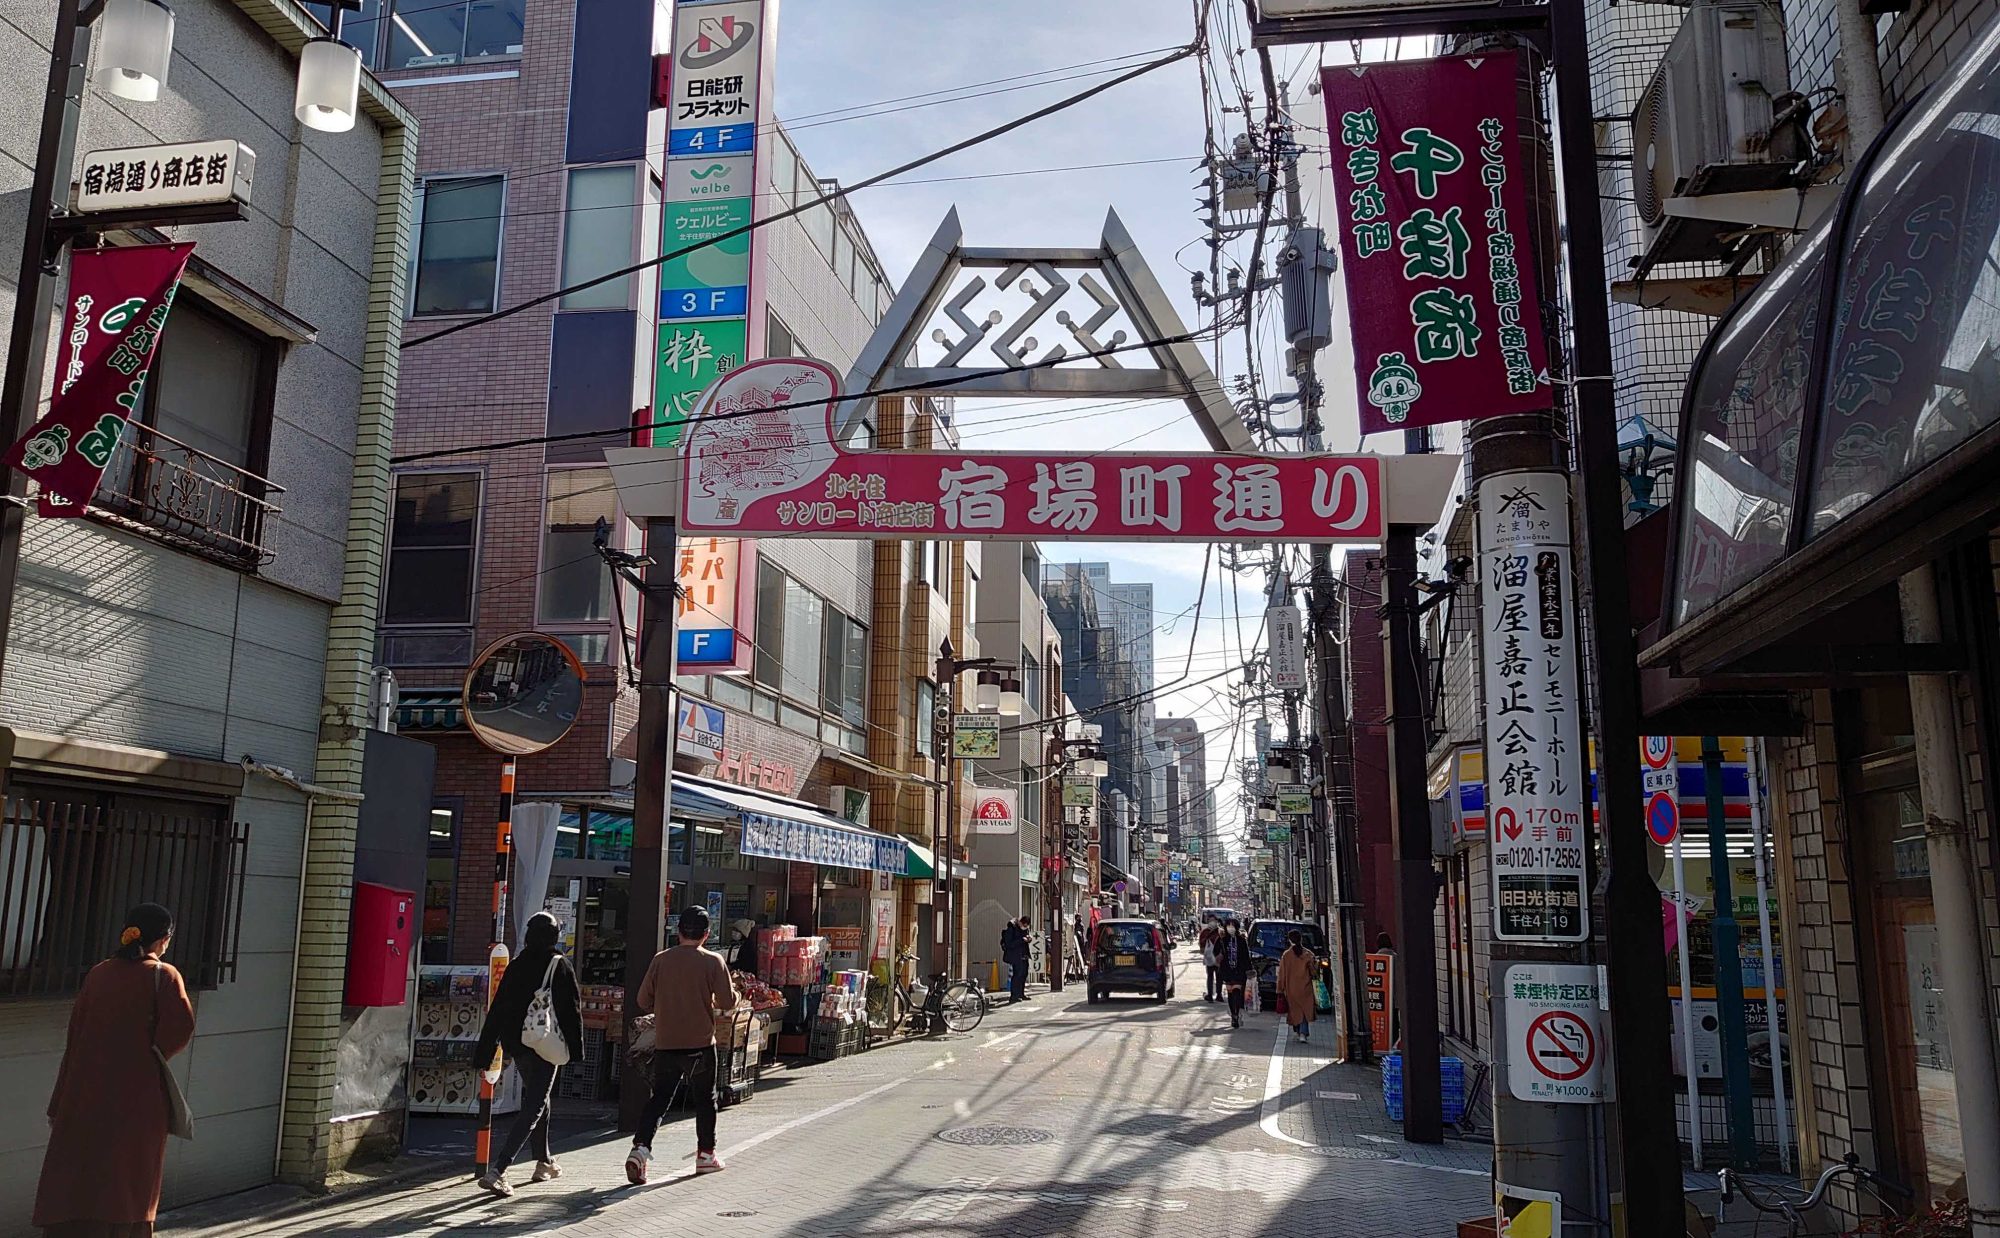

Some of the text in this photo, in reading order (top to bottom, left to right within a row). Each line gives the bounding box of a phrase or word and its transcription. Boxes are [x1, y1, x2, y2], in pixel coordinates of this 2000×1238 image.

[687, 75, 743, 98] 日能研
[678, 97, 750, 121] プラネット
[84, 152, 229, 197] 宿場通り商店街
[690, 183, 731, 195] welbe
[675, 212, 742, 230] ウェルビー
[825, 474, 886, 500] 北千住
[939, 459, 1371, 533] 宿場町通り
[777, 500, 936, 528] サンロード商店街
[1496, 520, 1550, 534] たまりや
[1492, 552, 1542, 797] 溜屋嘉正会館
[1543, 643, 1568, 796] セレモニーホール
[1646, 773, 1673, 788] 区域内
[990, 819, 1012, 827] VEGAS
[1525, 808, 1580, 825] 170m
[1532, 826, 1572, 842] 手前
[1509, 847, 1582, 869] 0120-17-2562
[1500, 889, 1579, 907] 旧日光街道
[1509, 915, 1569, 929] 千住4-19
[1512, 973, 1533, 981] ここは
[1555, 1085, 1589, 1096] ¥1,000
